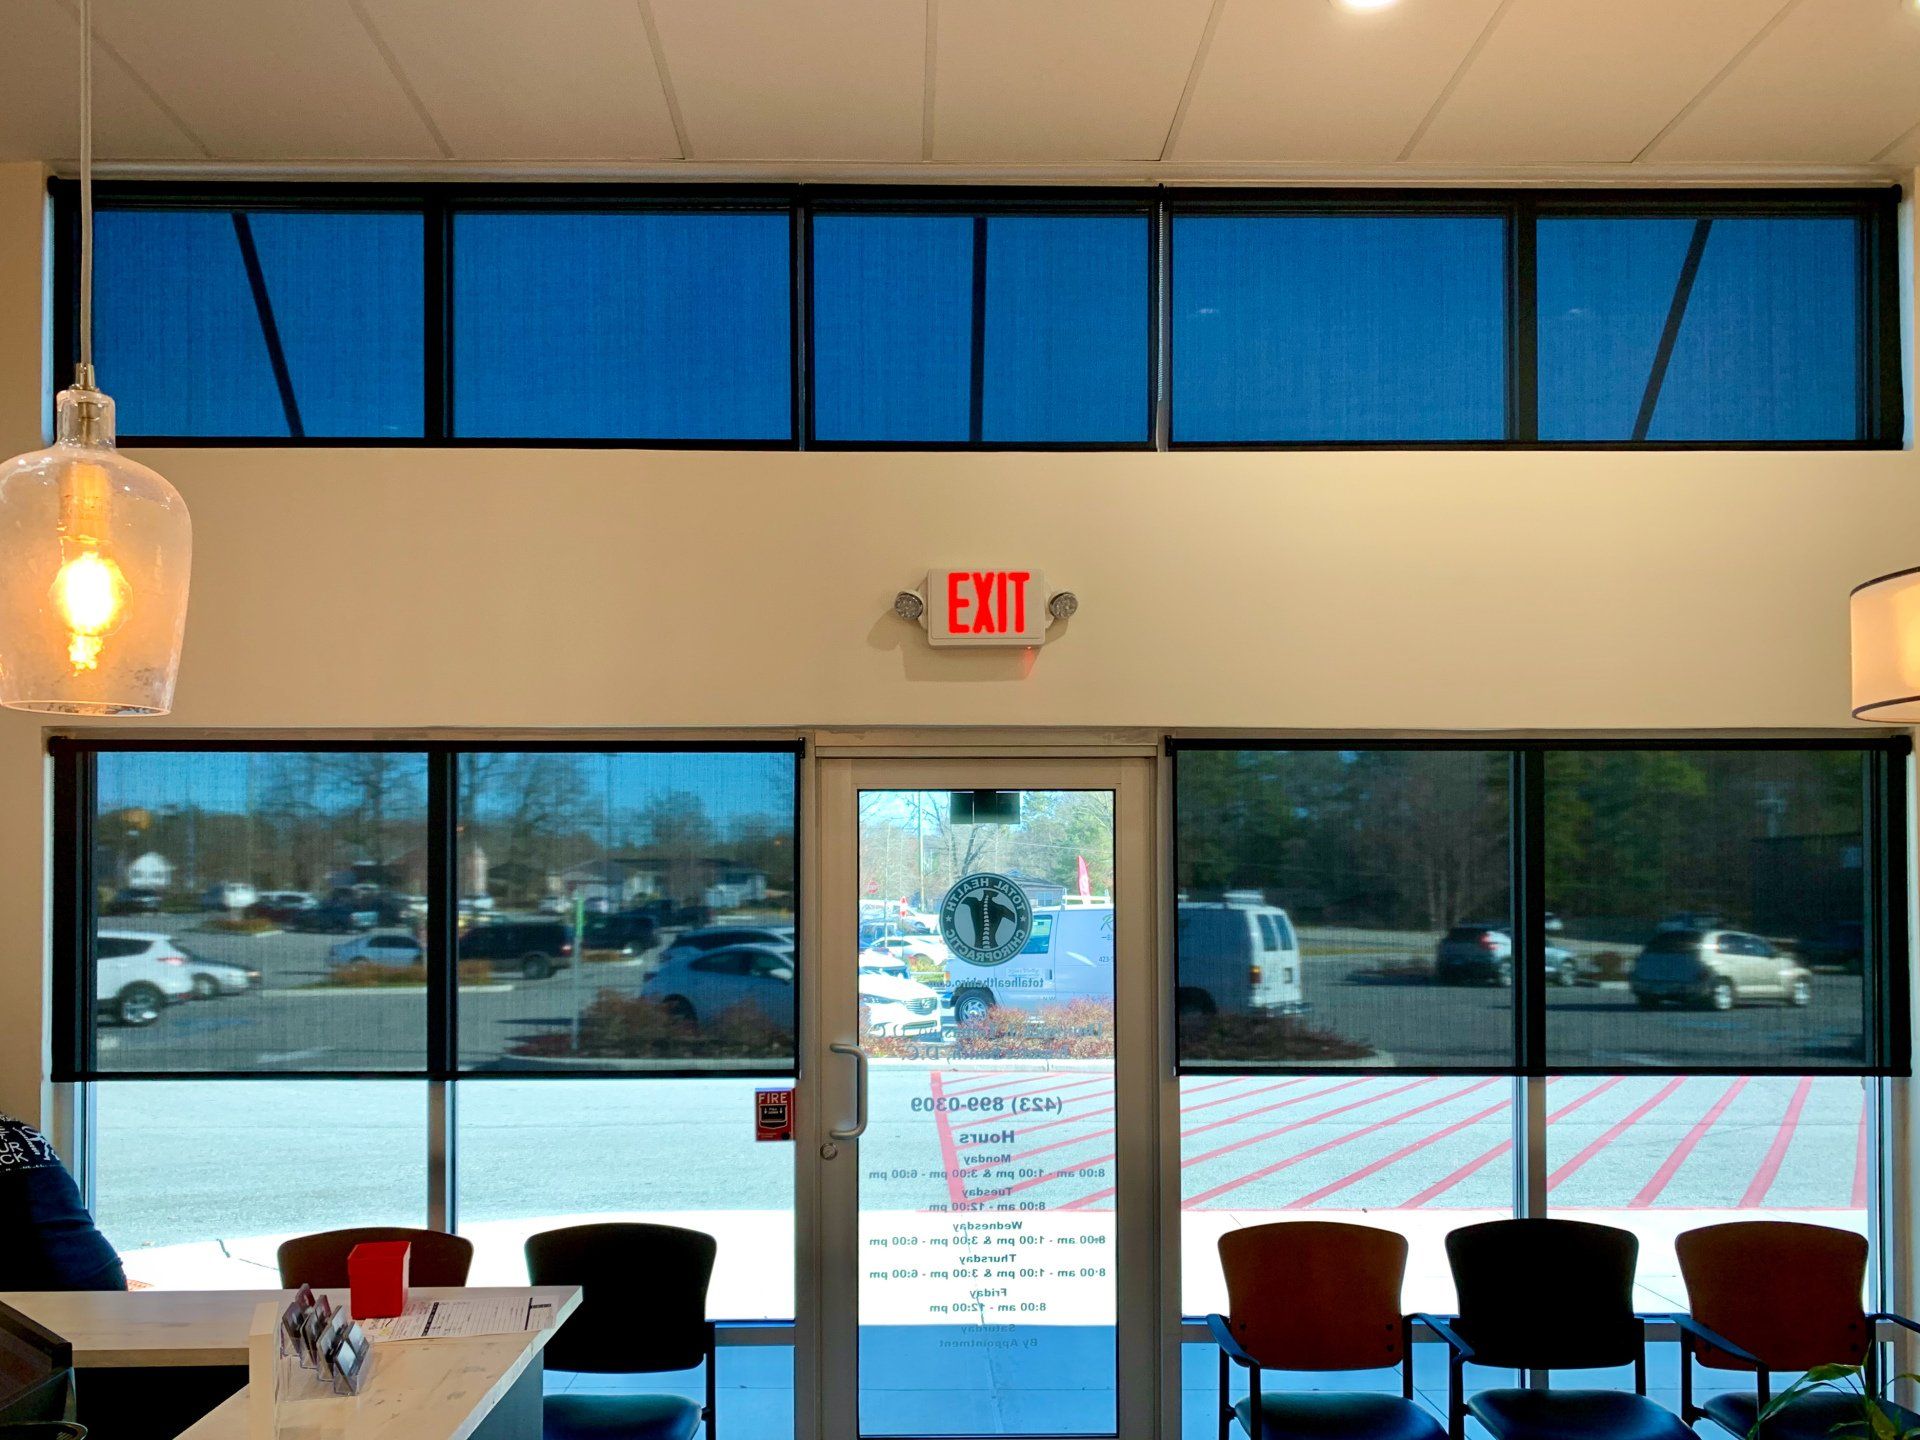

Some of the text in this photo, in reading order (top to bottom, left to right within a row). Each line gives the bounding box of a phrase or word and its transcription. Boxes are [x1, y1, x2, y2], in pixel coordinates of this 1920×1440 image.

[948, 572, 1030, 633] EXIT
[758, 1093, 788, 1104] FIRE
[0, 1153, 29, 1165] CK
